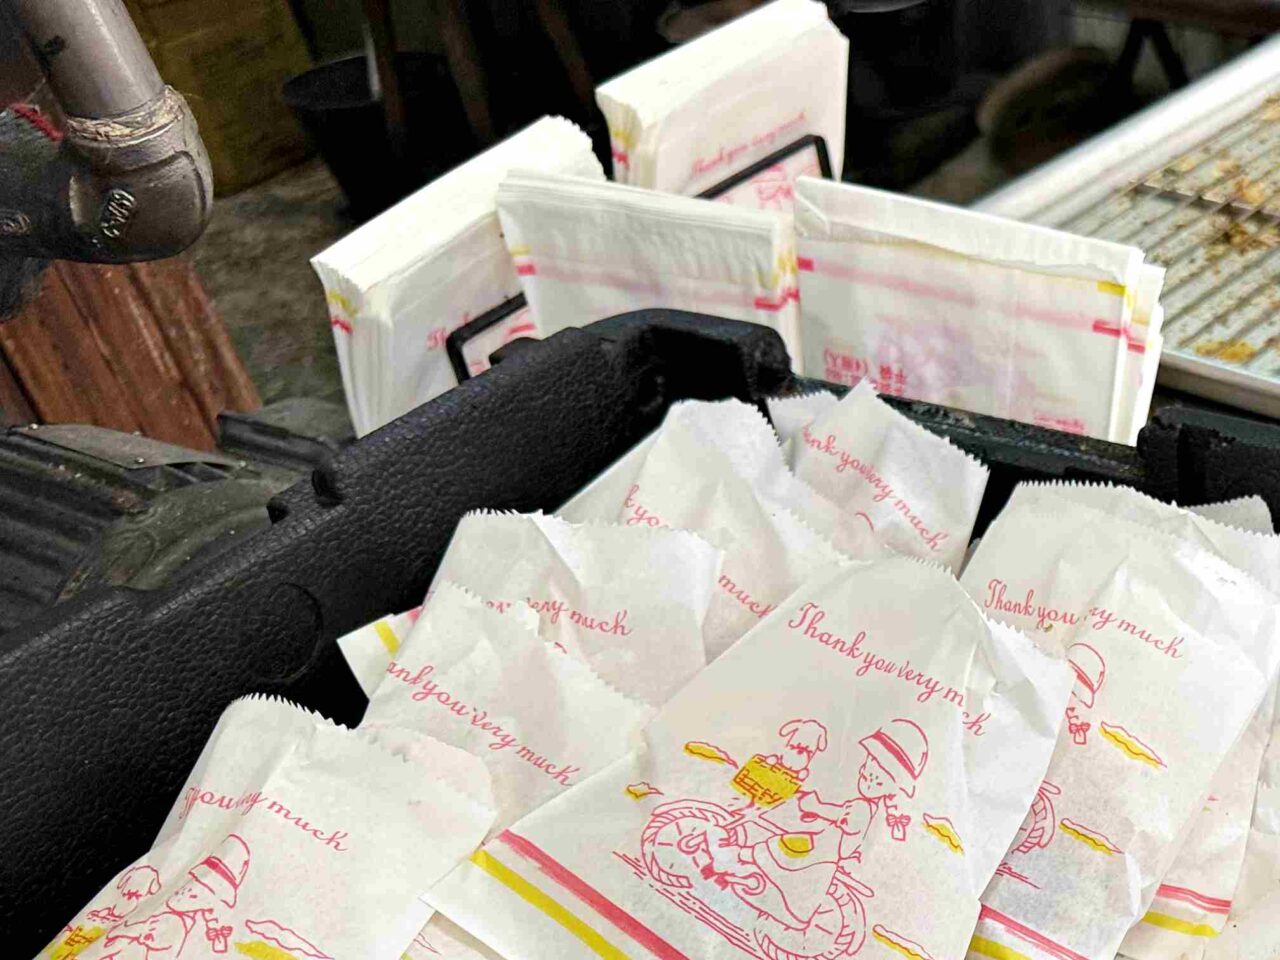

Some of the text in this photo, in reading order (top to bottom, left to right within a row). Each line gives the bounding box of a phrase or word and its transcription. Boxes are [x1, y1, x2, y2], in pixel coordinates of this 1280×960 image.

[626, 505, 670, 529] yo
[894, 498, 949, 551] much
[569, 609, 632, 637] much
[788, 602, 864, 660] Thank
[856, 652, 898, 677] you
[983, 578, 1037, 618] Thank
[1117, 618, 1185, 660] much
[411, 679, 470, 717] you
[515, 746, 581, 787] much
[267, 800, 348, 852] much
